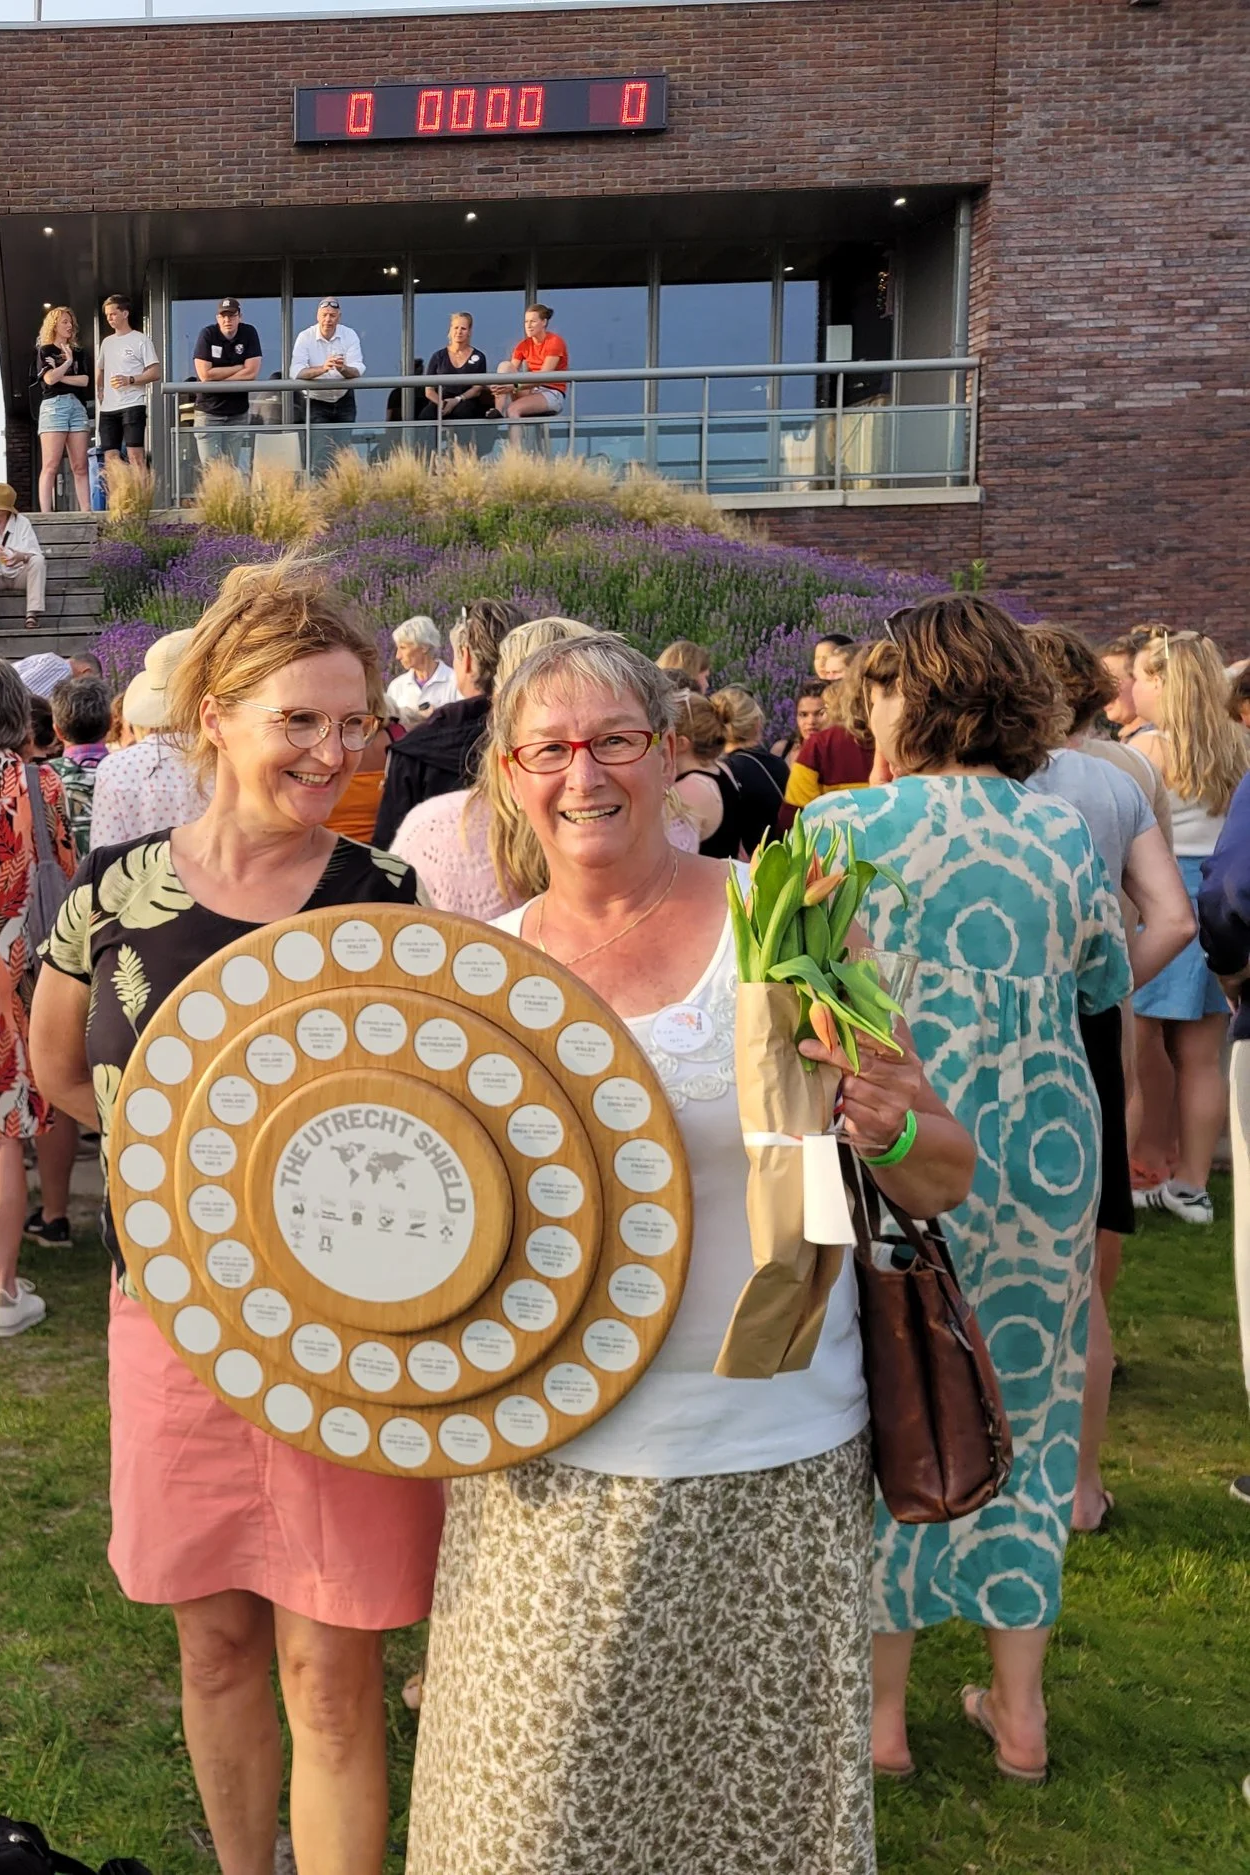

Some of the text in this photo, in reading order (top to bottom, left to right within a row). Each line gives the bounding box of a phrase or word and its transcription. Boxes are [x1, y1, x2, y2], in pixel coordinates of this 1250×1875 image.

[348, 92, 373, 133] 0
[621, 82, 647, 124] 0
[280, 1109, 467, 1214] THE UTRECHT SHIELD
